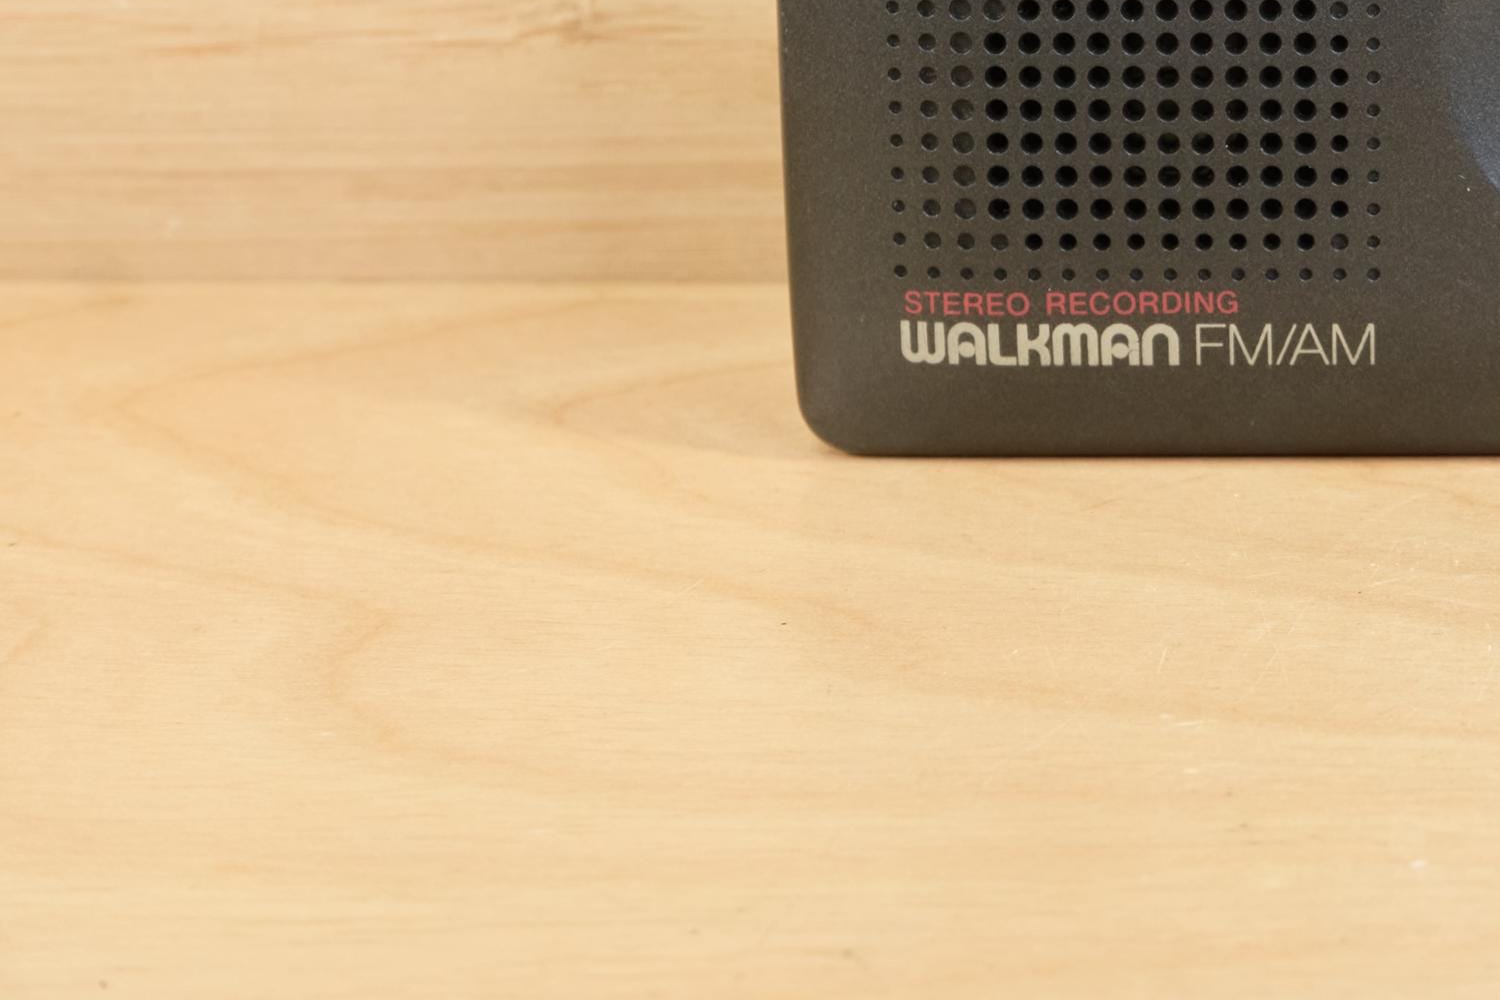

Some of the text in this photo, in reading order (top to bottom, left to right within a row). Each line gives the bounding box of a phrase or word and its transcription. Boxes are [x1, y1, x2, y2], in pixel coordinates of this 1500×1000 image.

[904, 290, 1239, 316] STEREO RECORDING
[900, 319, 1376, 366] WALKMAN FM/AM
